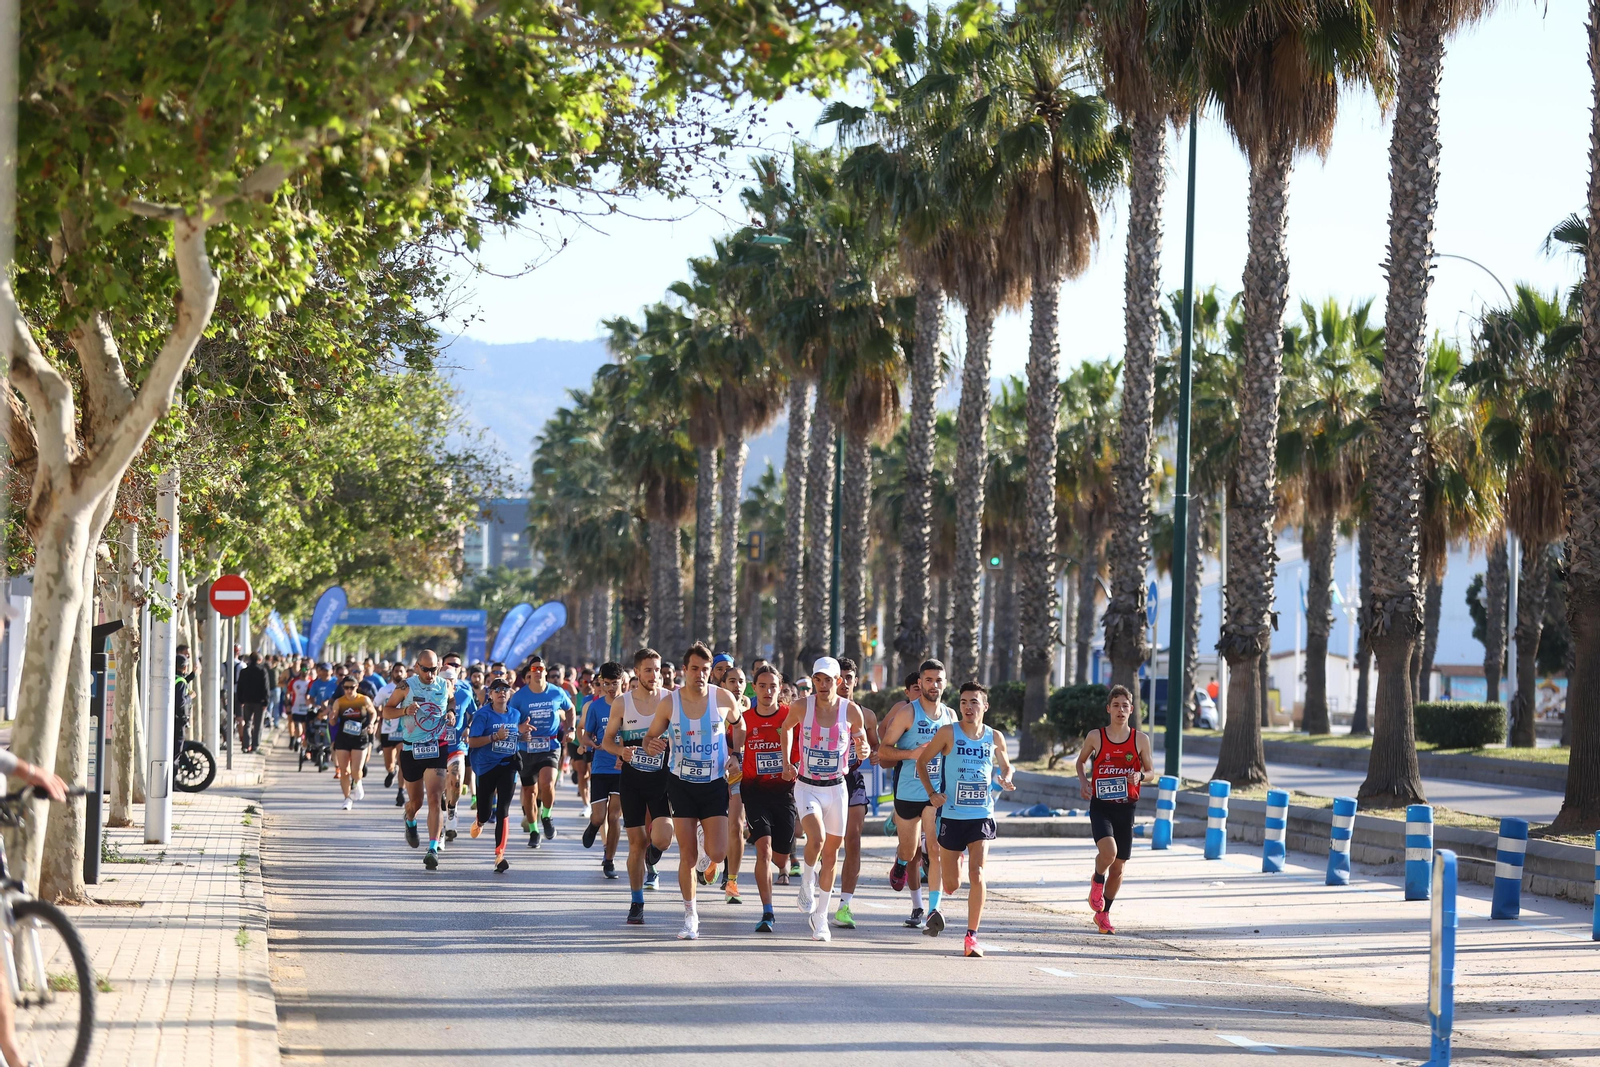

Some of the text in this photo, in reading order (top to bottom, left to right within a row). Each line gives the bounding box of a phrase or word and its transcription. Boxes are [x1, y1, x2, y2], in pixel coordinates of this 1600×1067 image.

[440, 612, 480, 623] mayoral
[917, 726, 938, 735] nerj
[957, 745, 991, 759] nerja
[635, 755, 659, 765] 1992
[817, 758, 830, 766] 25
[690, 767, 703, 776] 26
[1100, 785, 1124, 793] 2149
